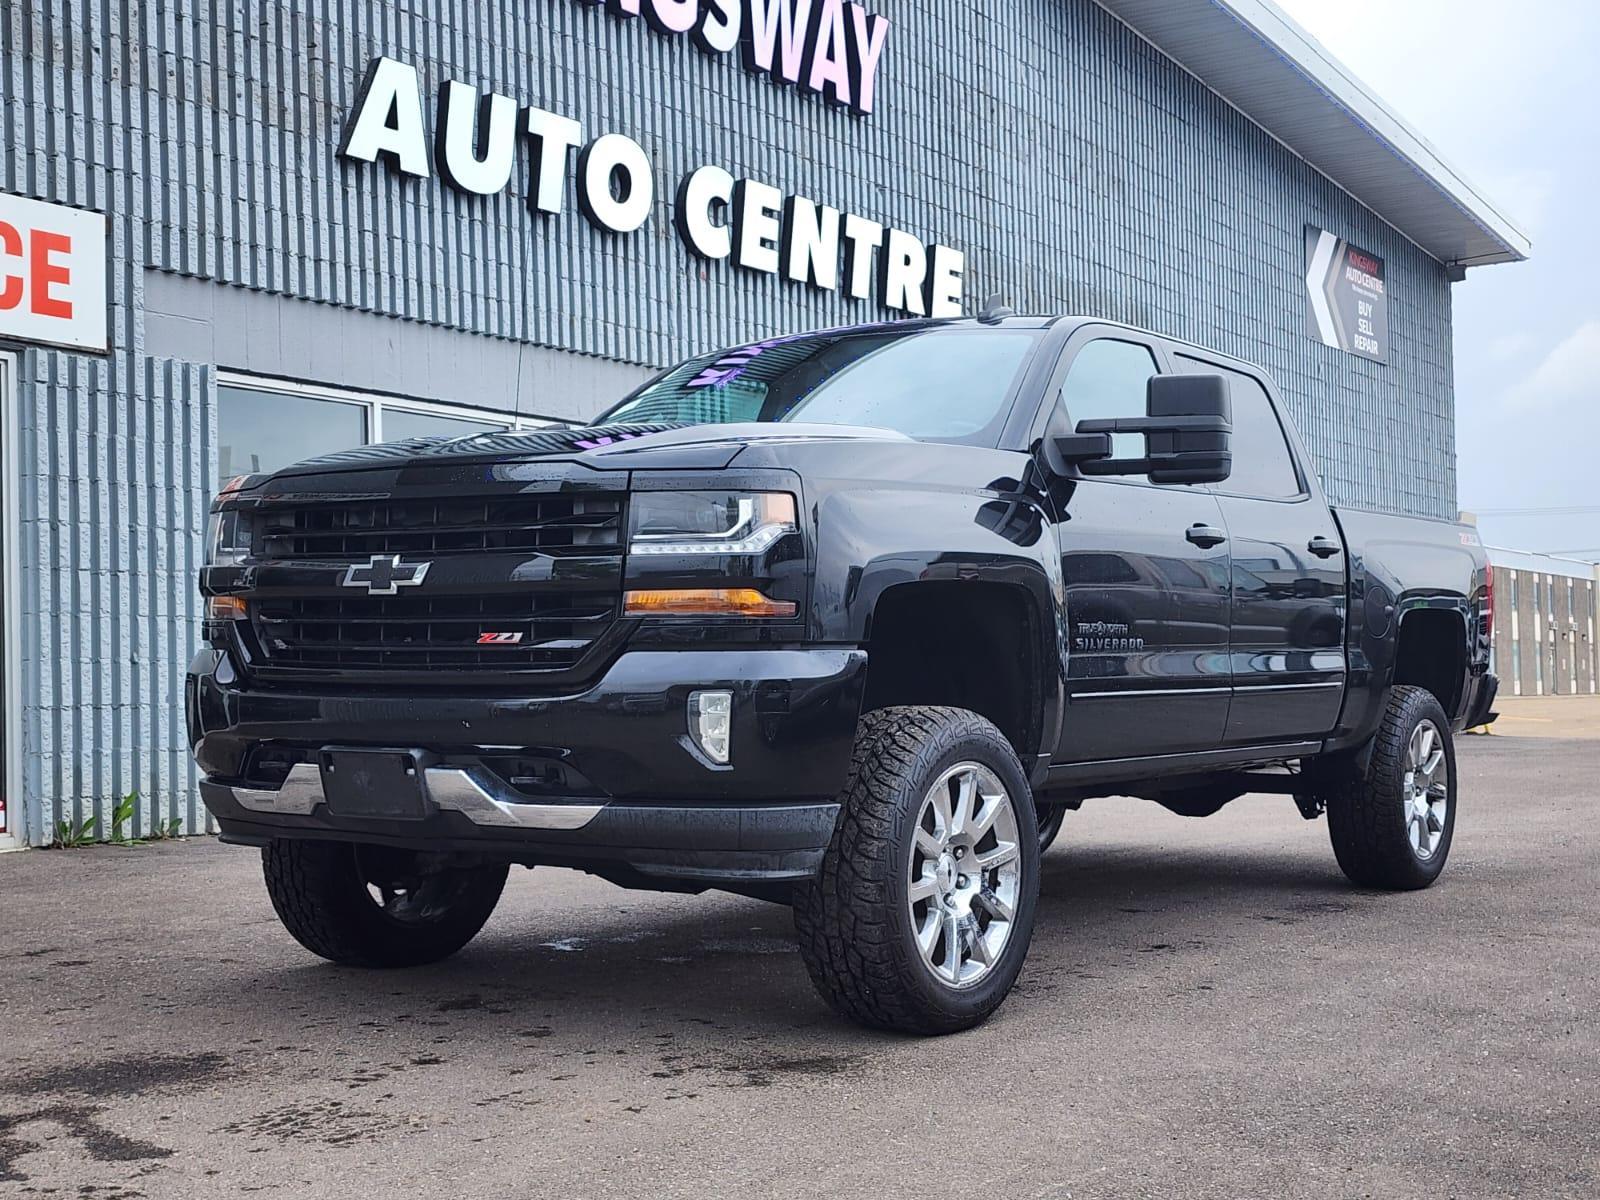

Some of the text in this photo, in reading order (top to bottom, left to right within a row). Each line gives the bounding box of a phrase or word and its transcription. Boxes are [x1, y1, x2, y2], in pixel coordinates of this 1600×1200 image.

[344, 56, 965, 318] AUTO CENTRE
[1345, 266, 1362, 285] AUTO
[1362, 273, 1384, 294] CENTRE
[1358, 300, 1373, 318] BUY
[1358, 318, 1375, 337] SELL
[1354, 333, 1379, 356] REPAIR
[1075, 637, 1144, 650] SILVERADO
